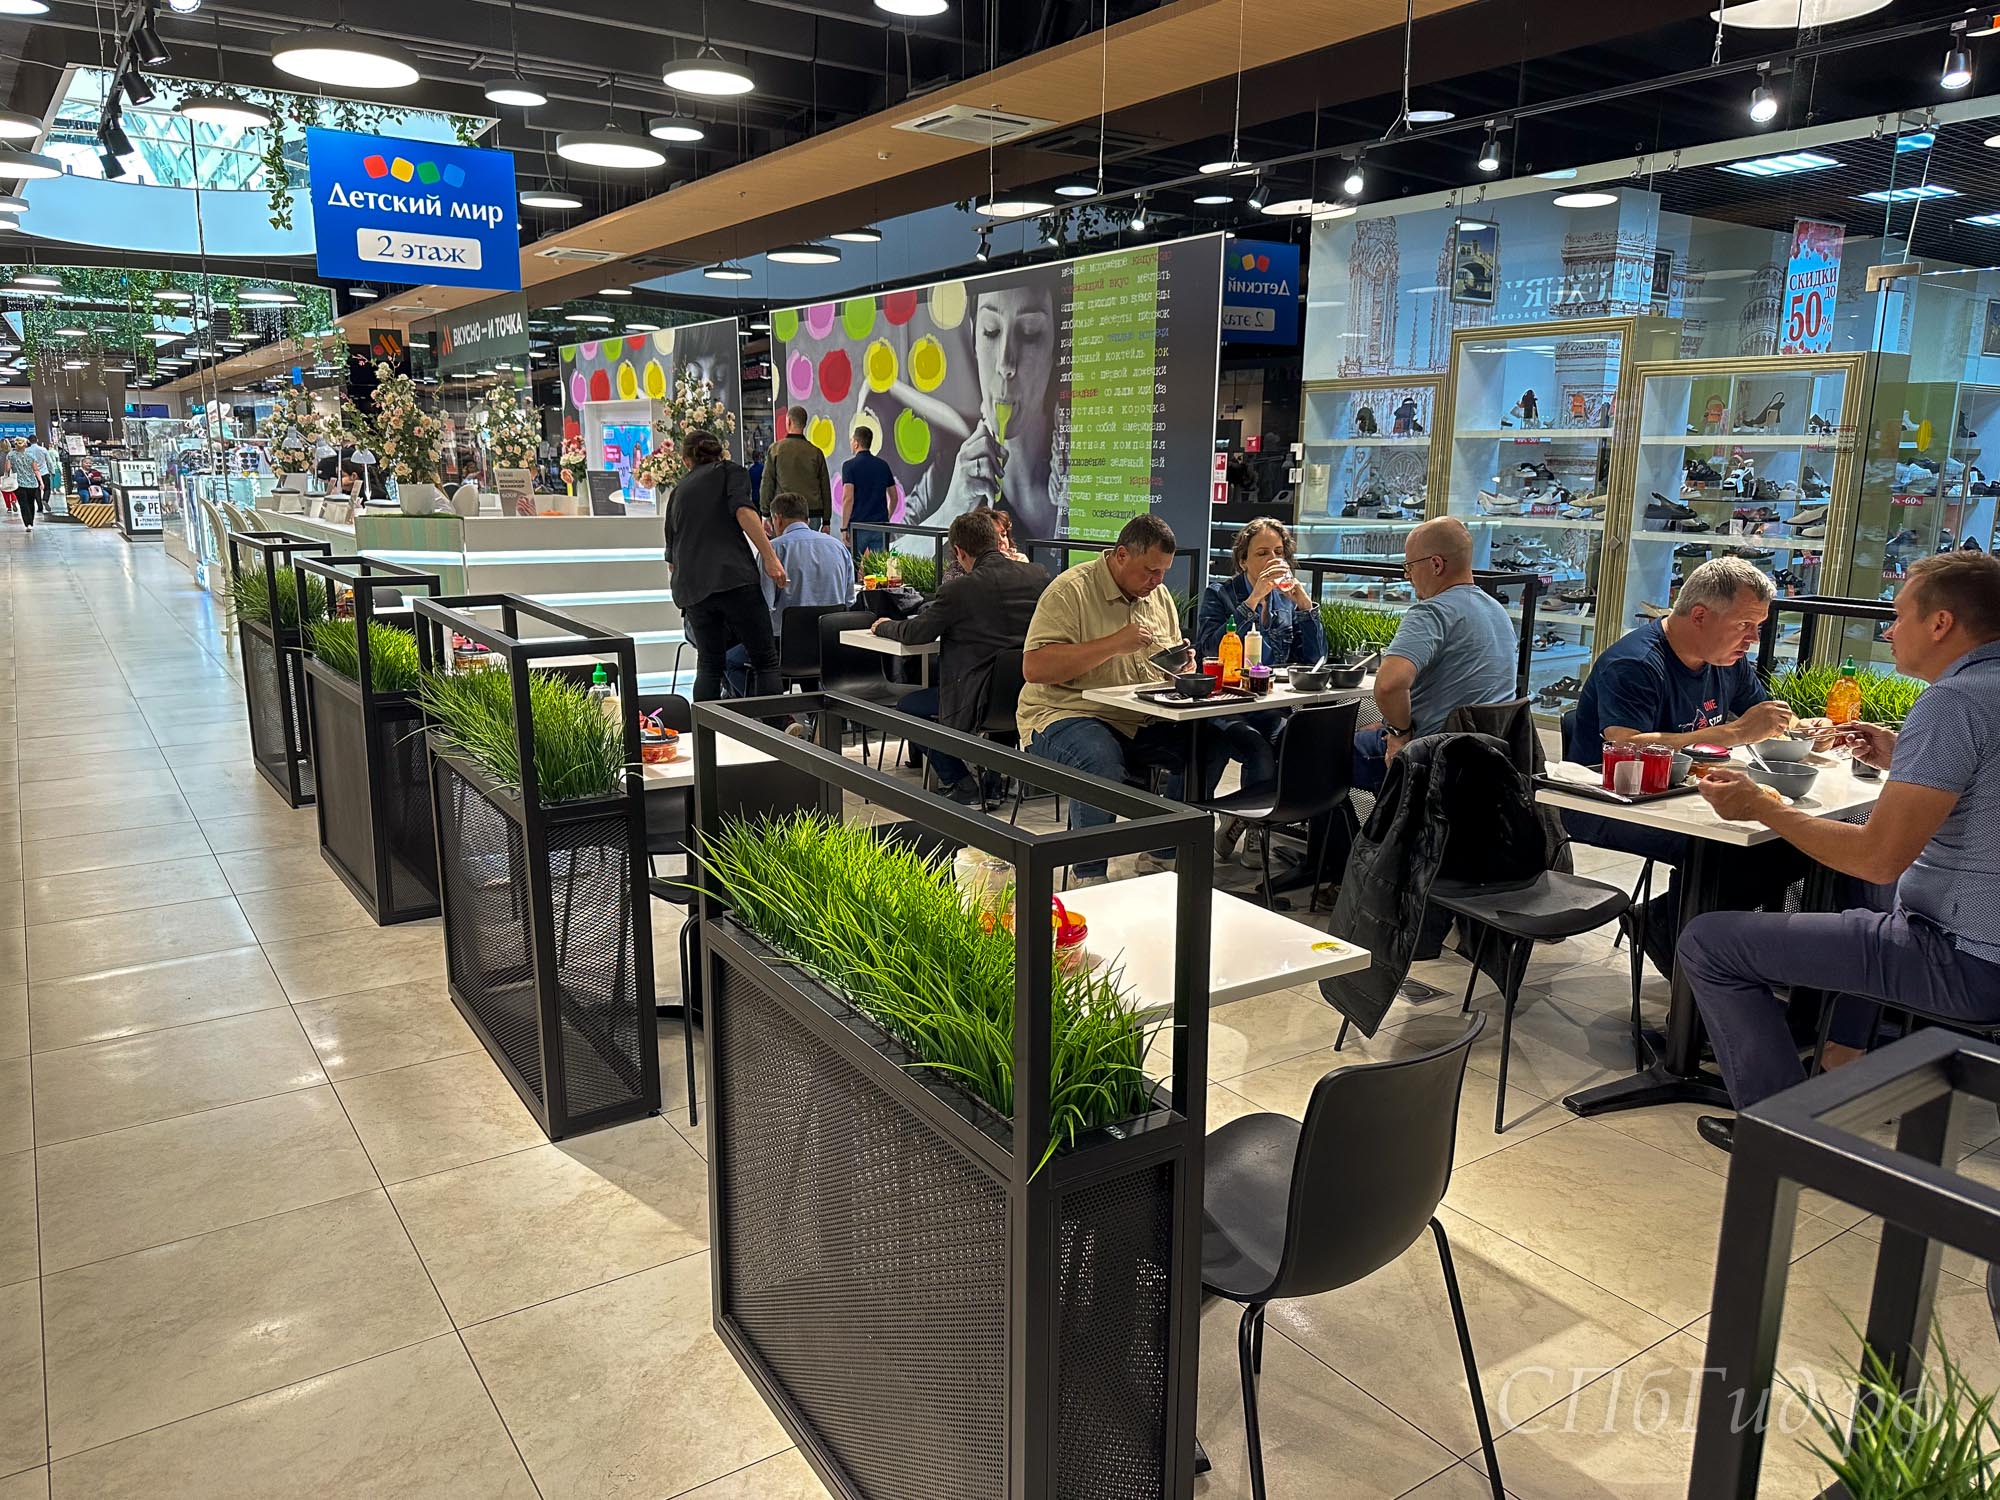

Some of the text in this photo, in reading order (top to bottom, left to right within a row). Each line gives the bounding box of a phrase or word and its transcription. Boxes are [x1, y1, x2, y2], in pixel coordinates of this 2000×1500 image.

[327, 182, 504, 230] Детский мир
[377, 235, 467, 264] 2 этаж
[1789, 266, 1838, 291] СКИДКИ
[1823, 285, 1836, 300] ДО
[453, 321, 481, 347] ВКУСНО
[495, 312, 524, 337] ТОЧКА
[1060, 351, 1101, 365] молочный
[1105, 348, 1145, 362] коктейль
[1059, 402, 1166, 419] хрустящая корочка
[1095, 421, 1117, 432] собой
[1059, 440, 1166, 452] приятная компания
[1704, 699, 1718, 711] ONE
